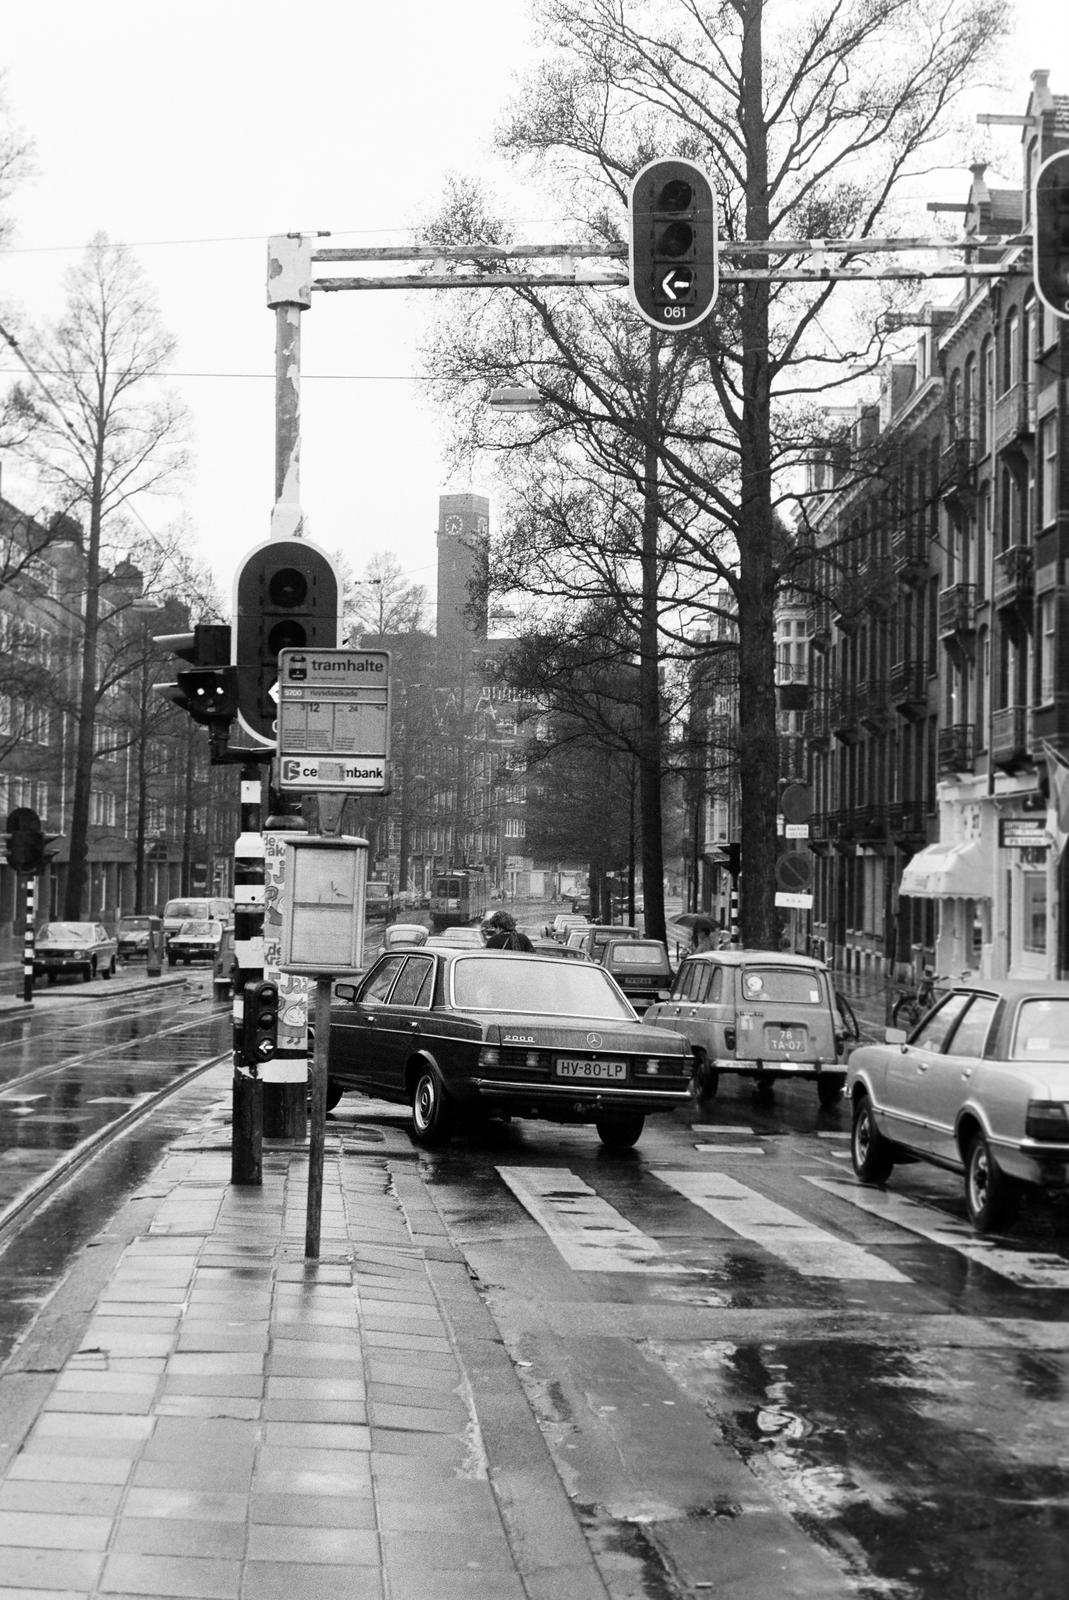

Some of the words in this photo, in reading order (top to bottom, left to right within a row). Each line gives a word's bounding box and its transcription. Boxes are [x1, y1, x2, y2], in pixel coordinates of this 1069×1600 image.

[664, 306, 686, 318] 061
[311, 659, 384, 672] tramhalte
[309, 703, 321, 713] 12
